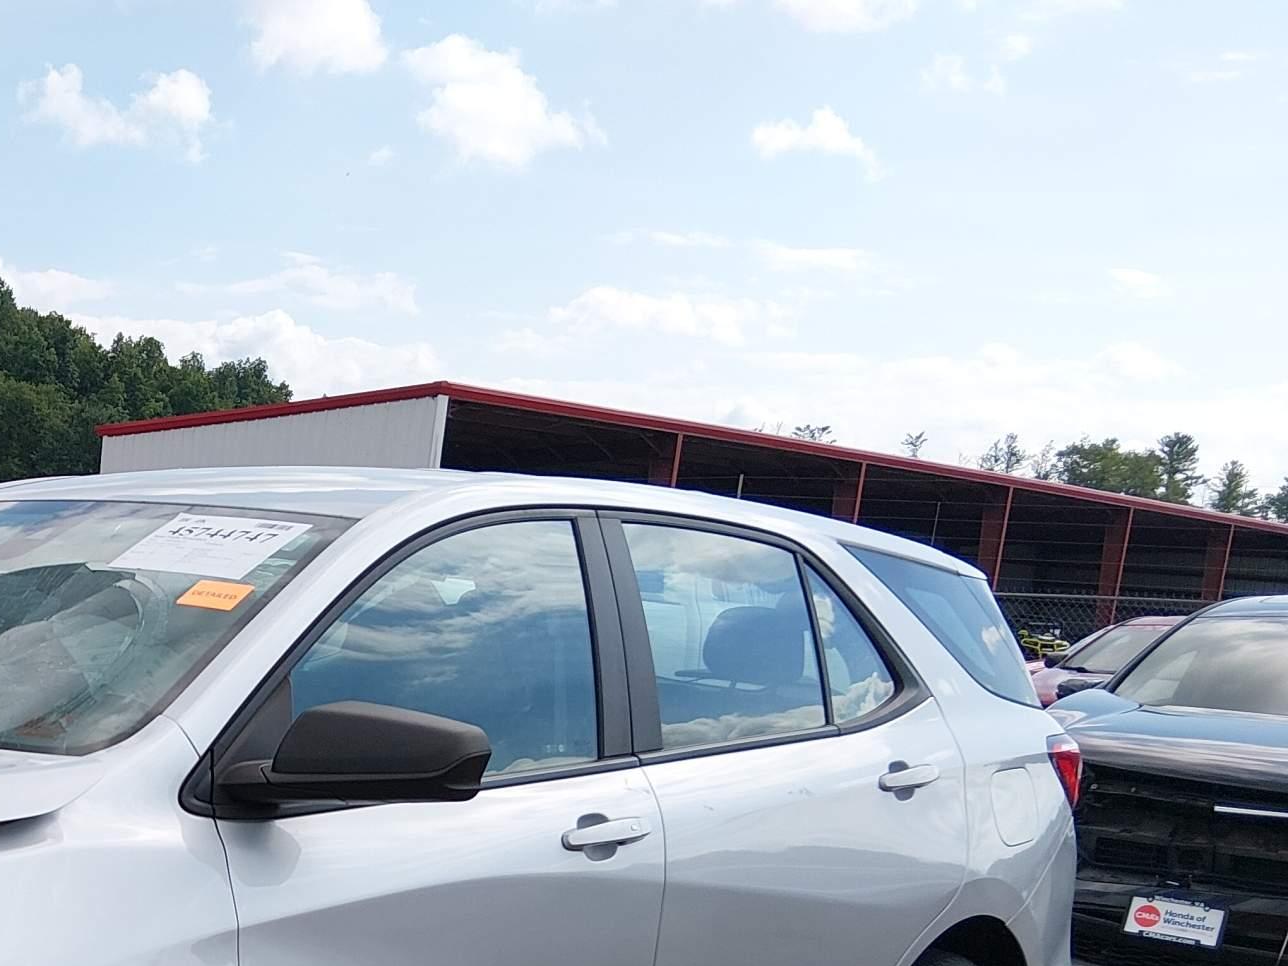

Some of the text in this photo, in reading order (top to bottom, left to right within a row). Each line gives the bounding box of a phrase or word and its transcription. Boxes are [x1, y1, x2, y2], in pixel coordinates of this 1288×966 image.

[168, 525, 280, 544] 45744747
[1164, 909, 1207, 923] Honda of
[1163, 917, 1215, 932] Winchester
